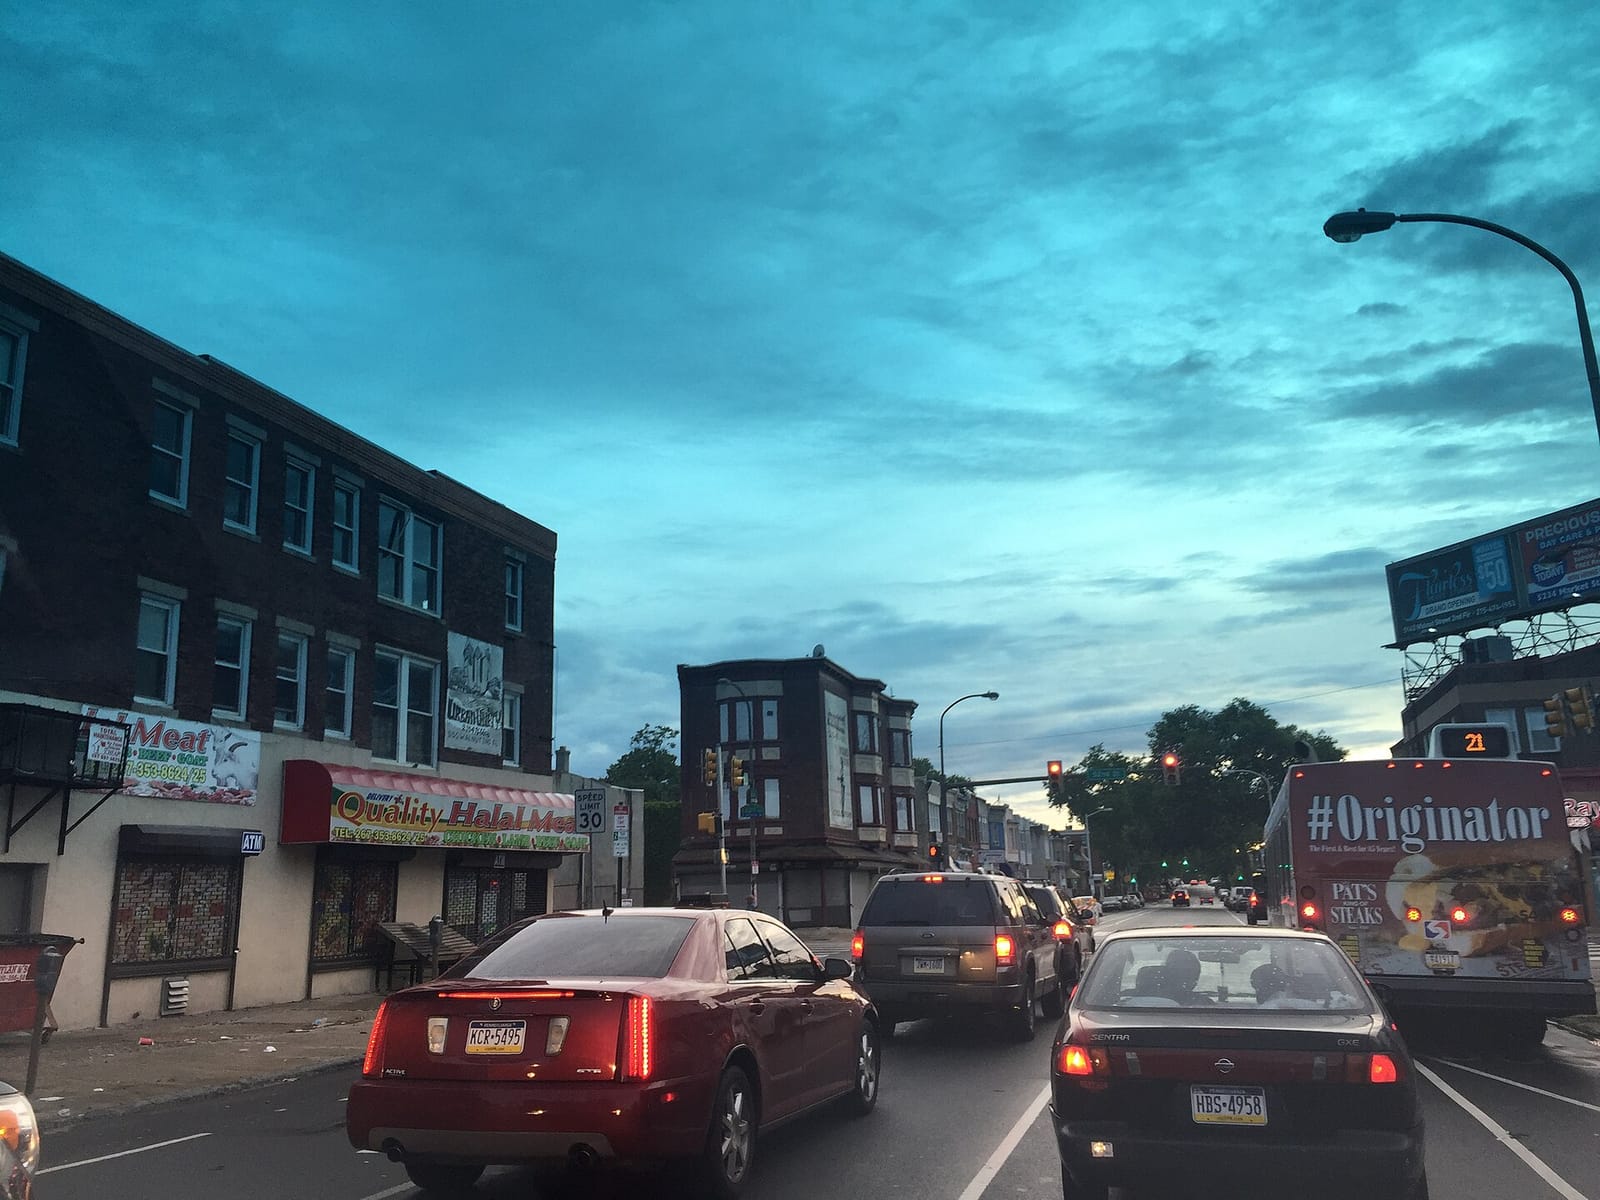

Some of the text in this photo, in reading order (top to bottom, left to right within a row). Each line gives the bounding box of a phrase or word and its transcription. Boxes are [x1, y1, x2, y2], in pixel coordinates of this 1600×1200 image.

[1525, 510, 1600, 542] PRECIOUS
[1540, 539, 1557, 549] DAY
[1560, 531, 1583, 543] CARE
[1478, 559, 1507, 590] $50
[1560, 582, 1585, 595] Market
[1447, 595, 1477, 609] OPENING
[129, 717, 212, 755] Meat
[1464, 733, 1486, 751] 21
[577, 792, 603, 801] SPEED
[337, 792, 575, 833] Quality Halal Mea
[580, 802, 600, 811] LIMIT
[579, 812, 602, 828] 30
[1307, 795, 1549, 854] #Originator
[243, 834, 262, 850] ATM
[1331, 882, 1377, 901] PAT'S
[1331, 907, 1384, 925] STEAKS
[1091, 1033, 1130, 1041] SENTRA
[1337, 1038, 1360, 1046] GXE
